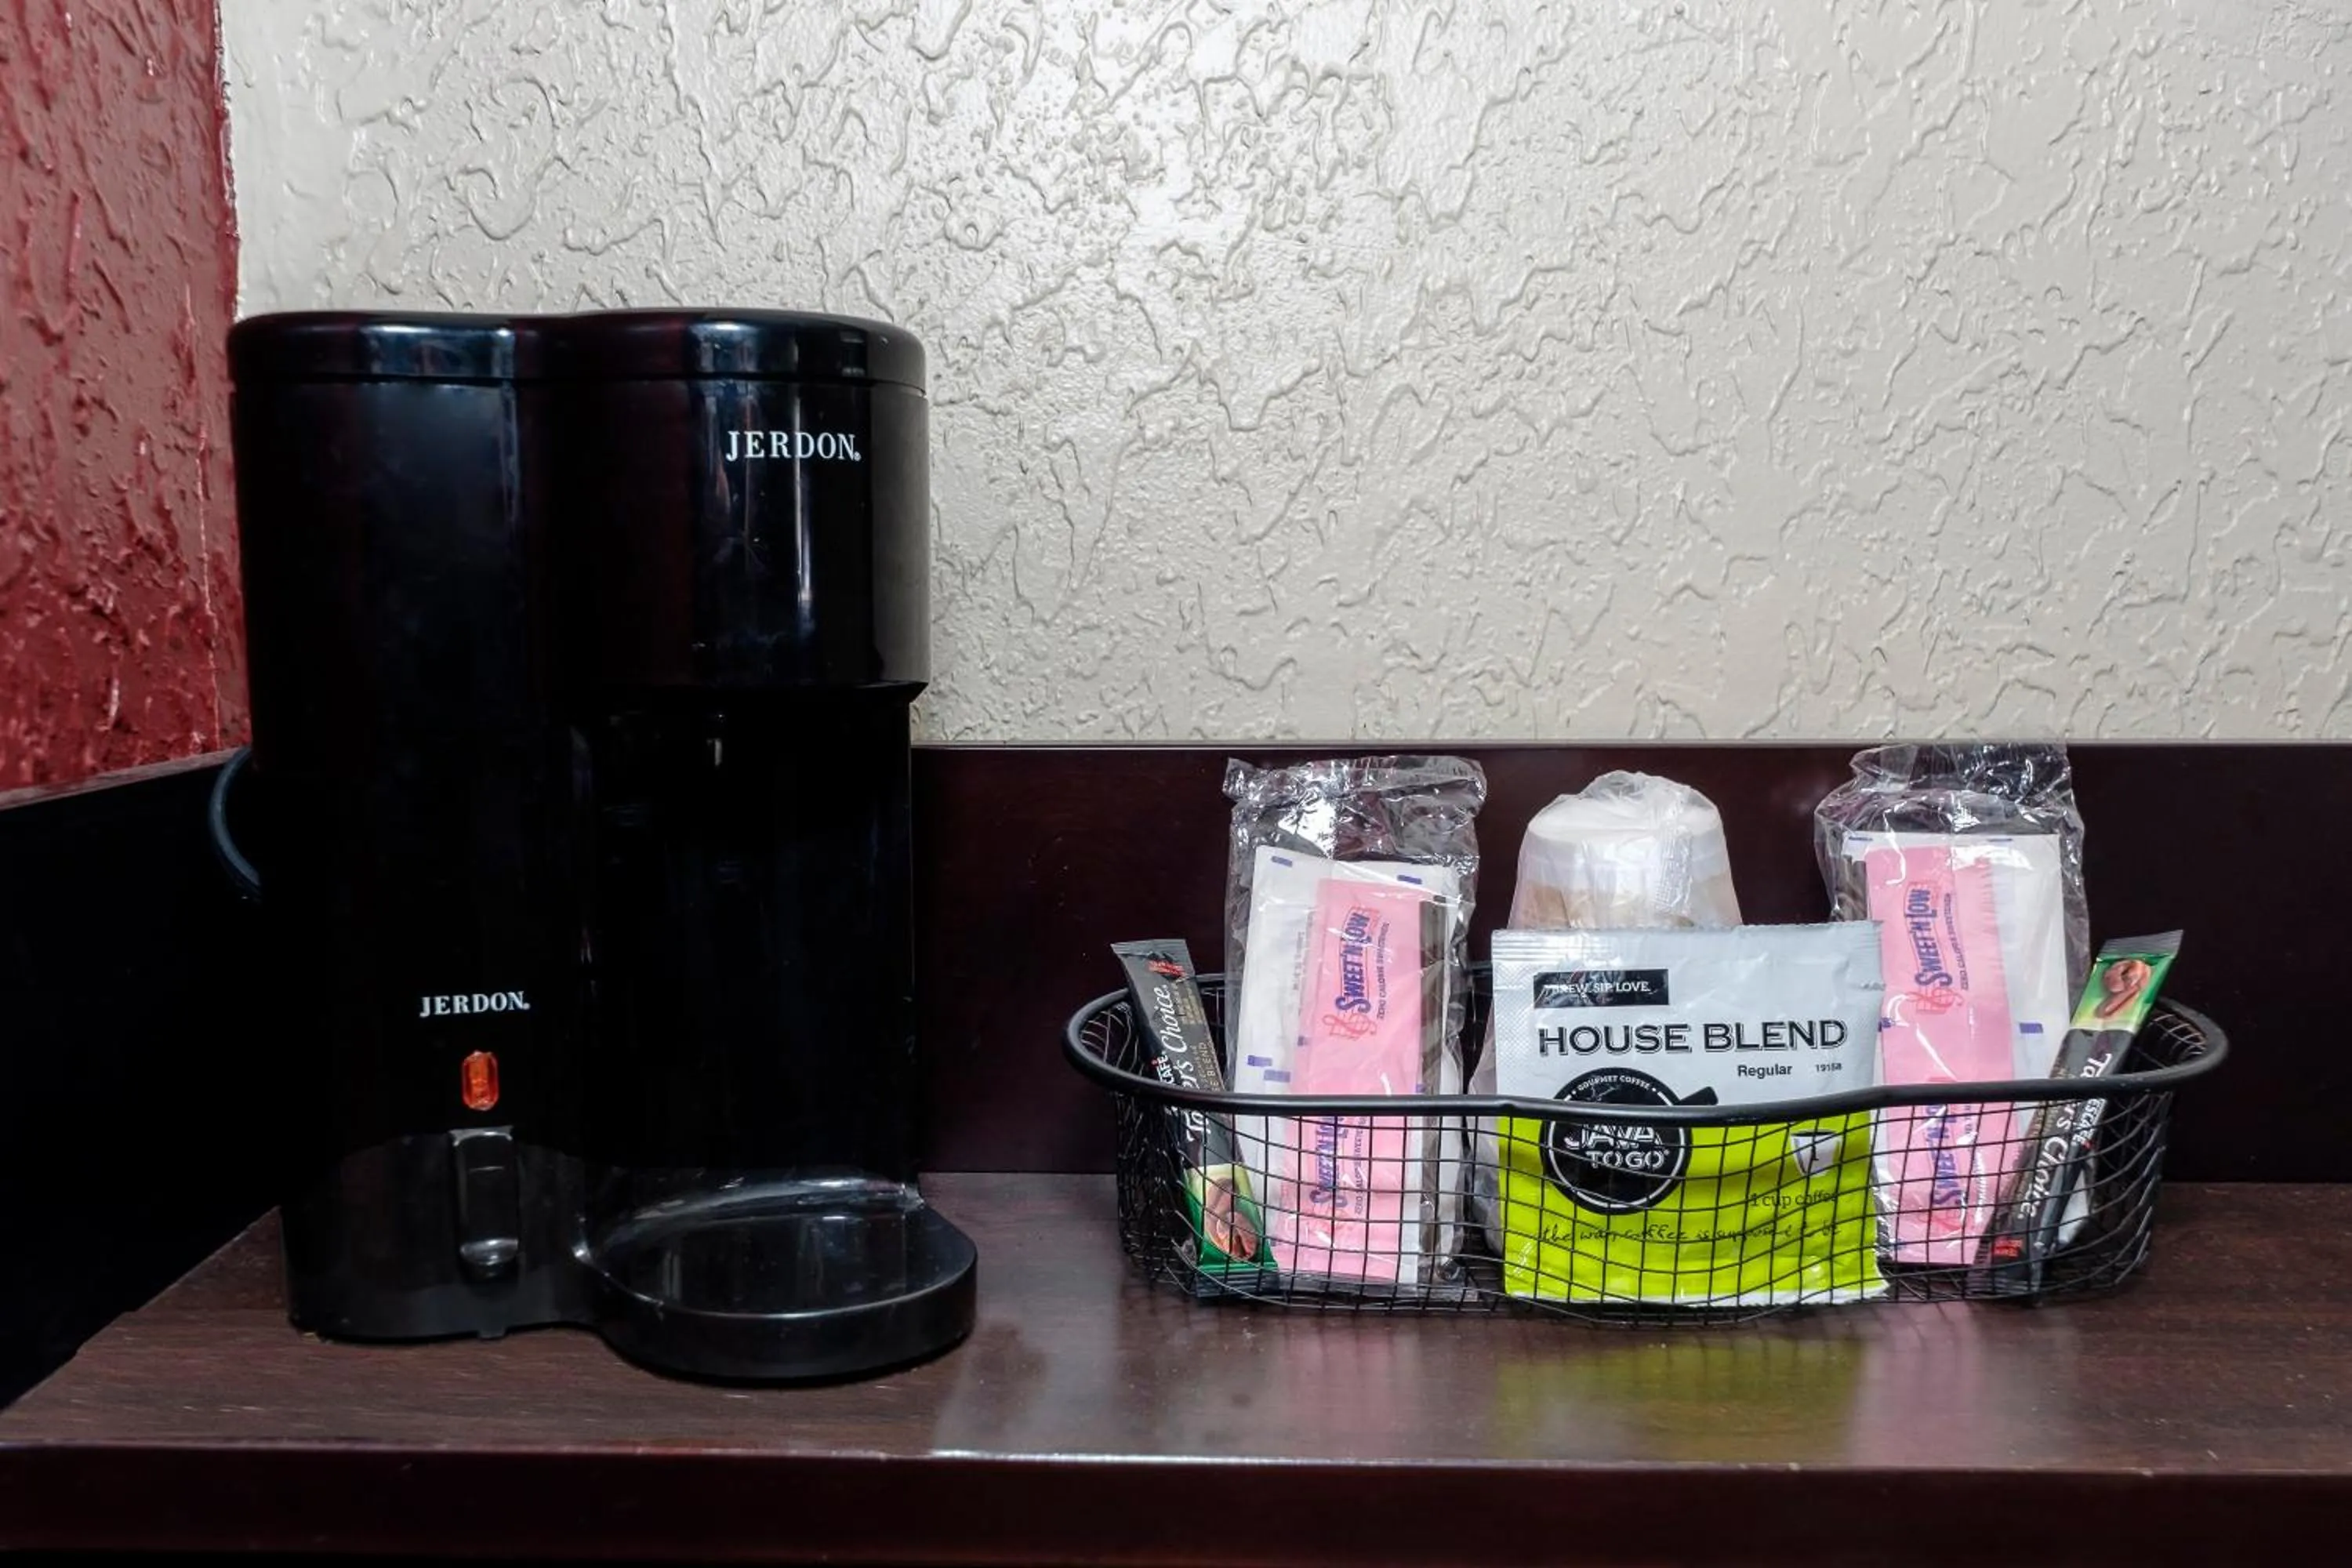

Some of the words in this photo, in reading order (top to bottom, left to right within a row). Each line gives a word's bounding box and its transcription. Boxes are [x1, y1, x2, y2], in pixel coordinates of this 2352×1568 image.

[1538, 1023, 1693, 1056] HOUSE
[1703, 1018, 1849, 1052] BLEND
[1737, 1064, 1793, 1080] Regular
[1619, 1075, 1650, 1091] COFFEE
[1762, 1195, 1792, 1209] cup
